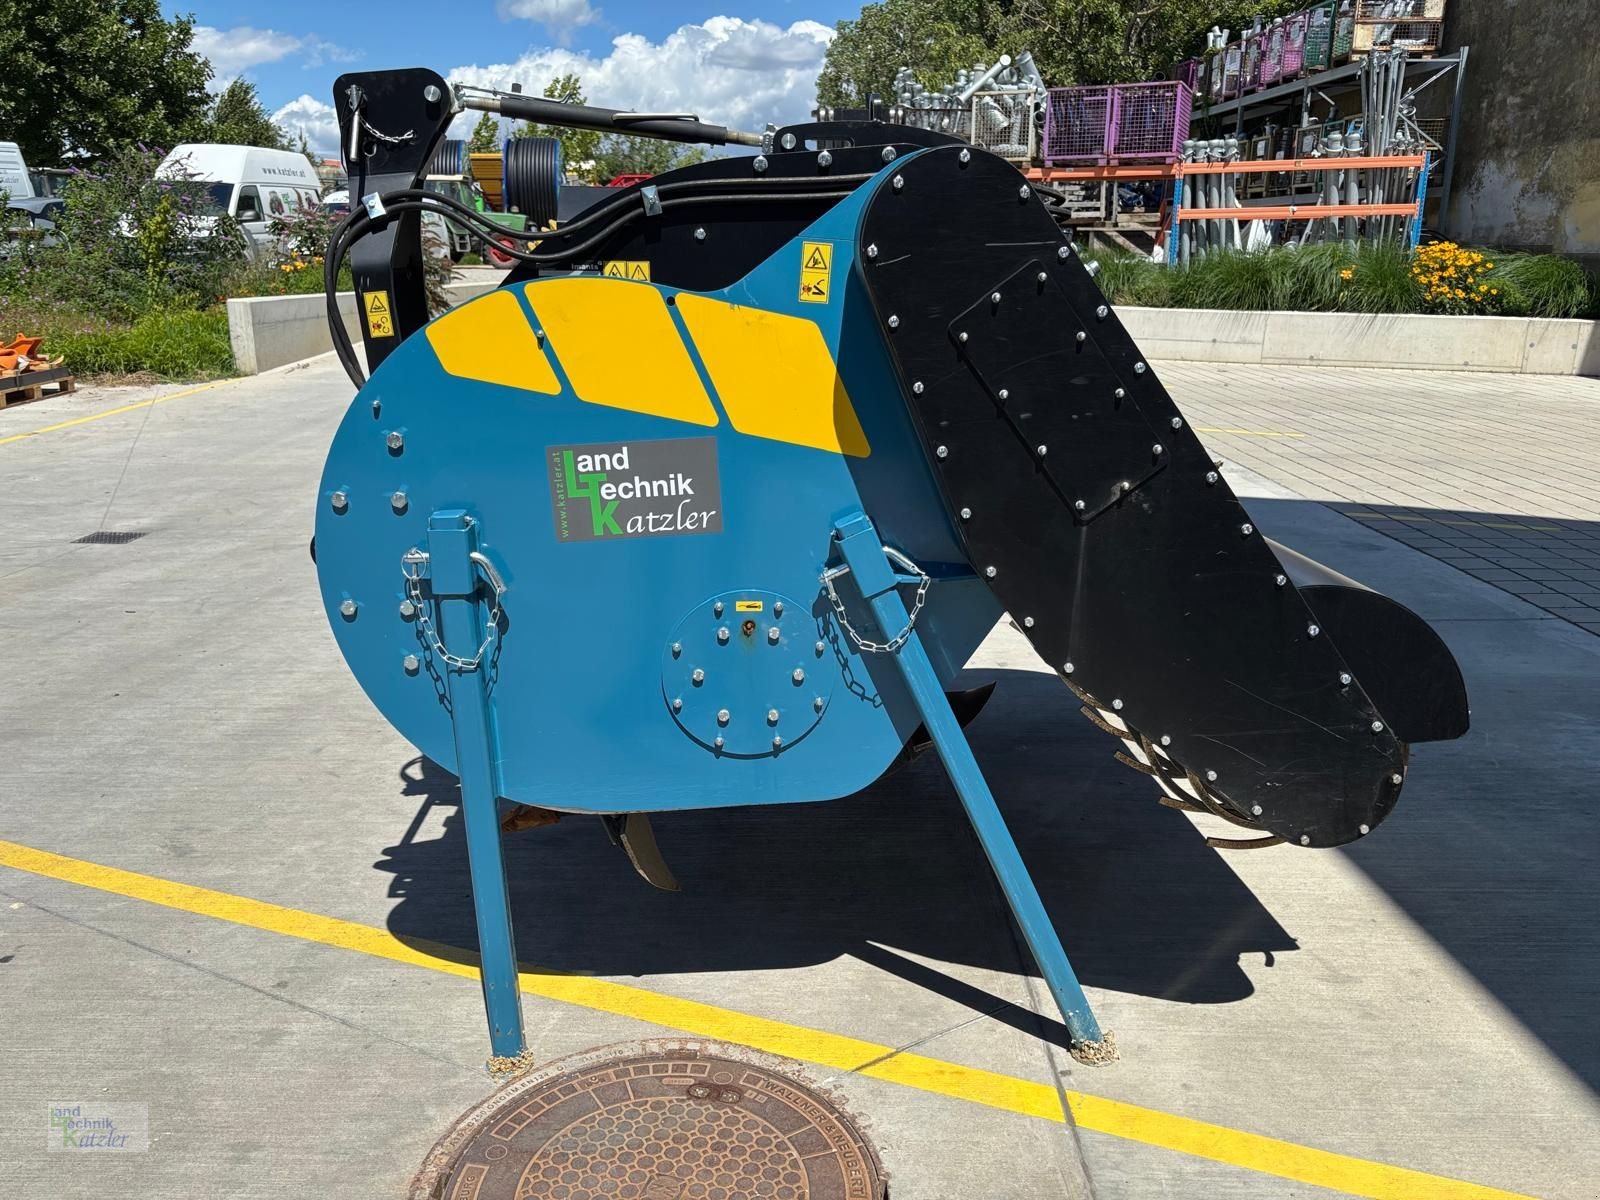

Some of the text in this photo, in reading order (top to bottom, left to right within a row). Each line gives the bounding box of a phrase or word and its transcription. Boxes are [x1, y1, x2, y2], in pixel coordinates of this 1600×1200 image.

[262, 167, 306, 178] www.katzler.at
[563, 446, 630, 498] Land
[579, 473, 695, 500] Technik
[552, 452, 569, 538] www.katzler.at
[592, 499, 716, 536] Katzler
[764, 1081, 865, 1196] WALLNER & NEUBERT
